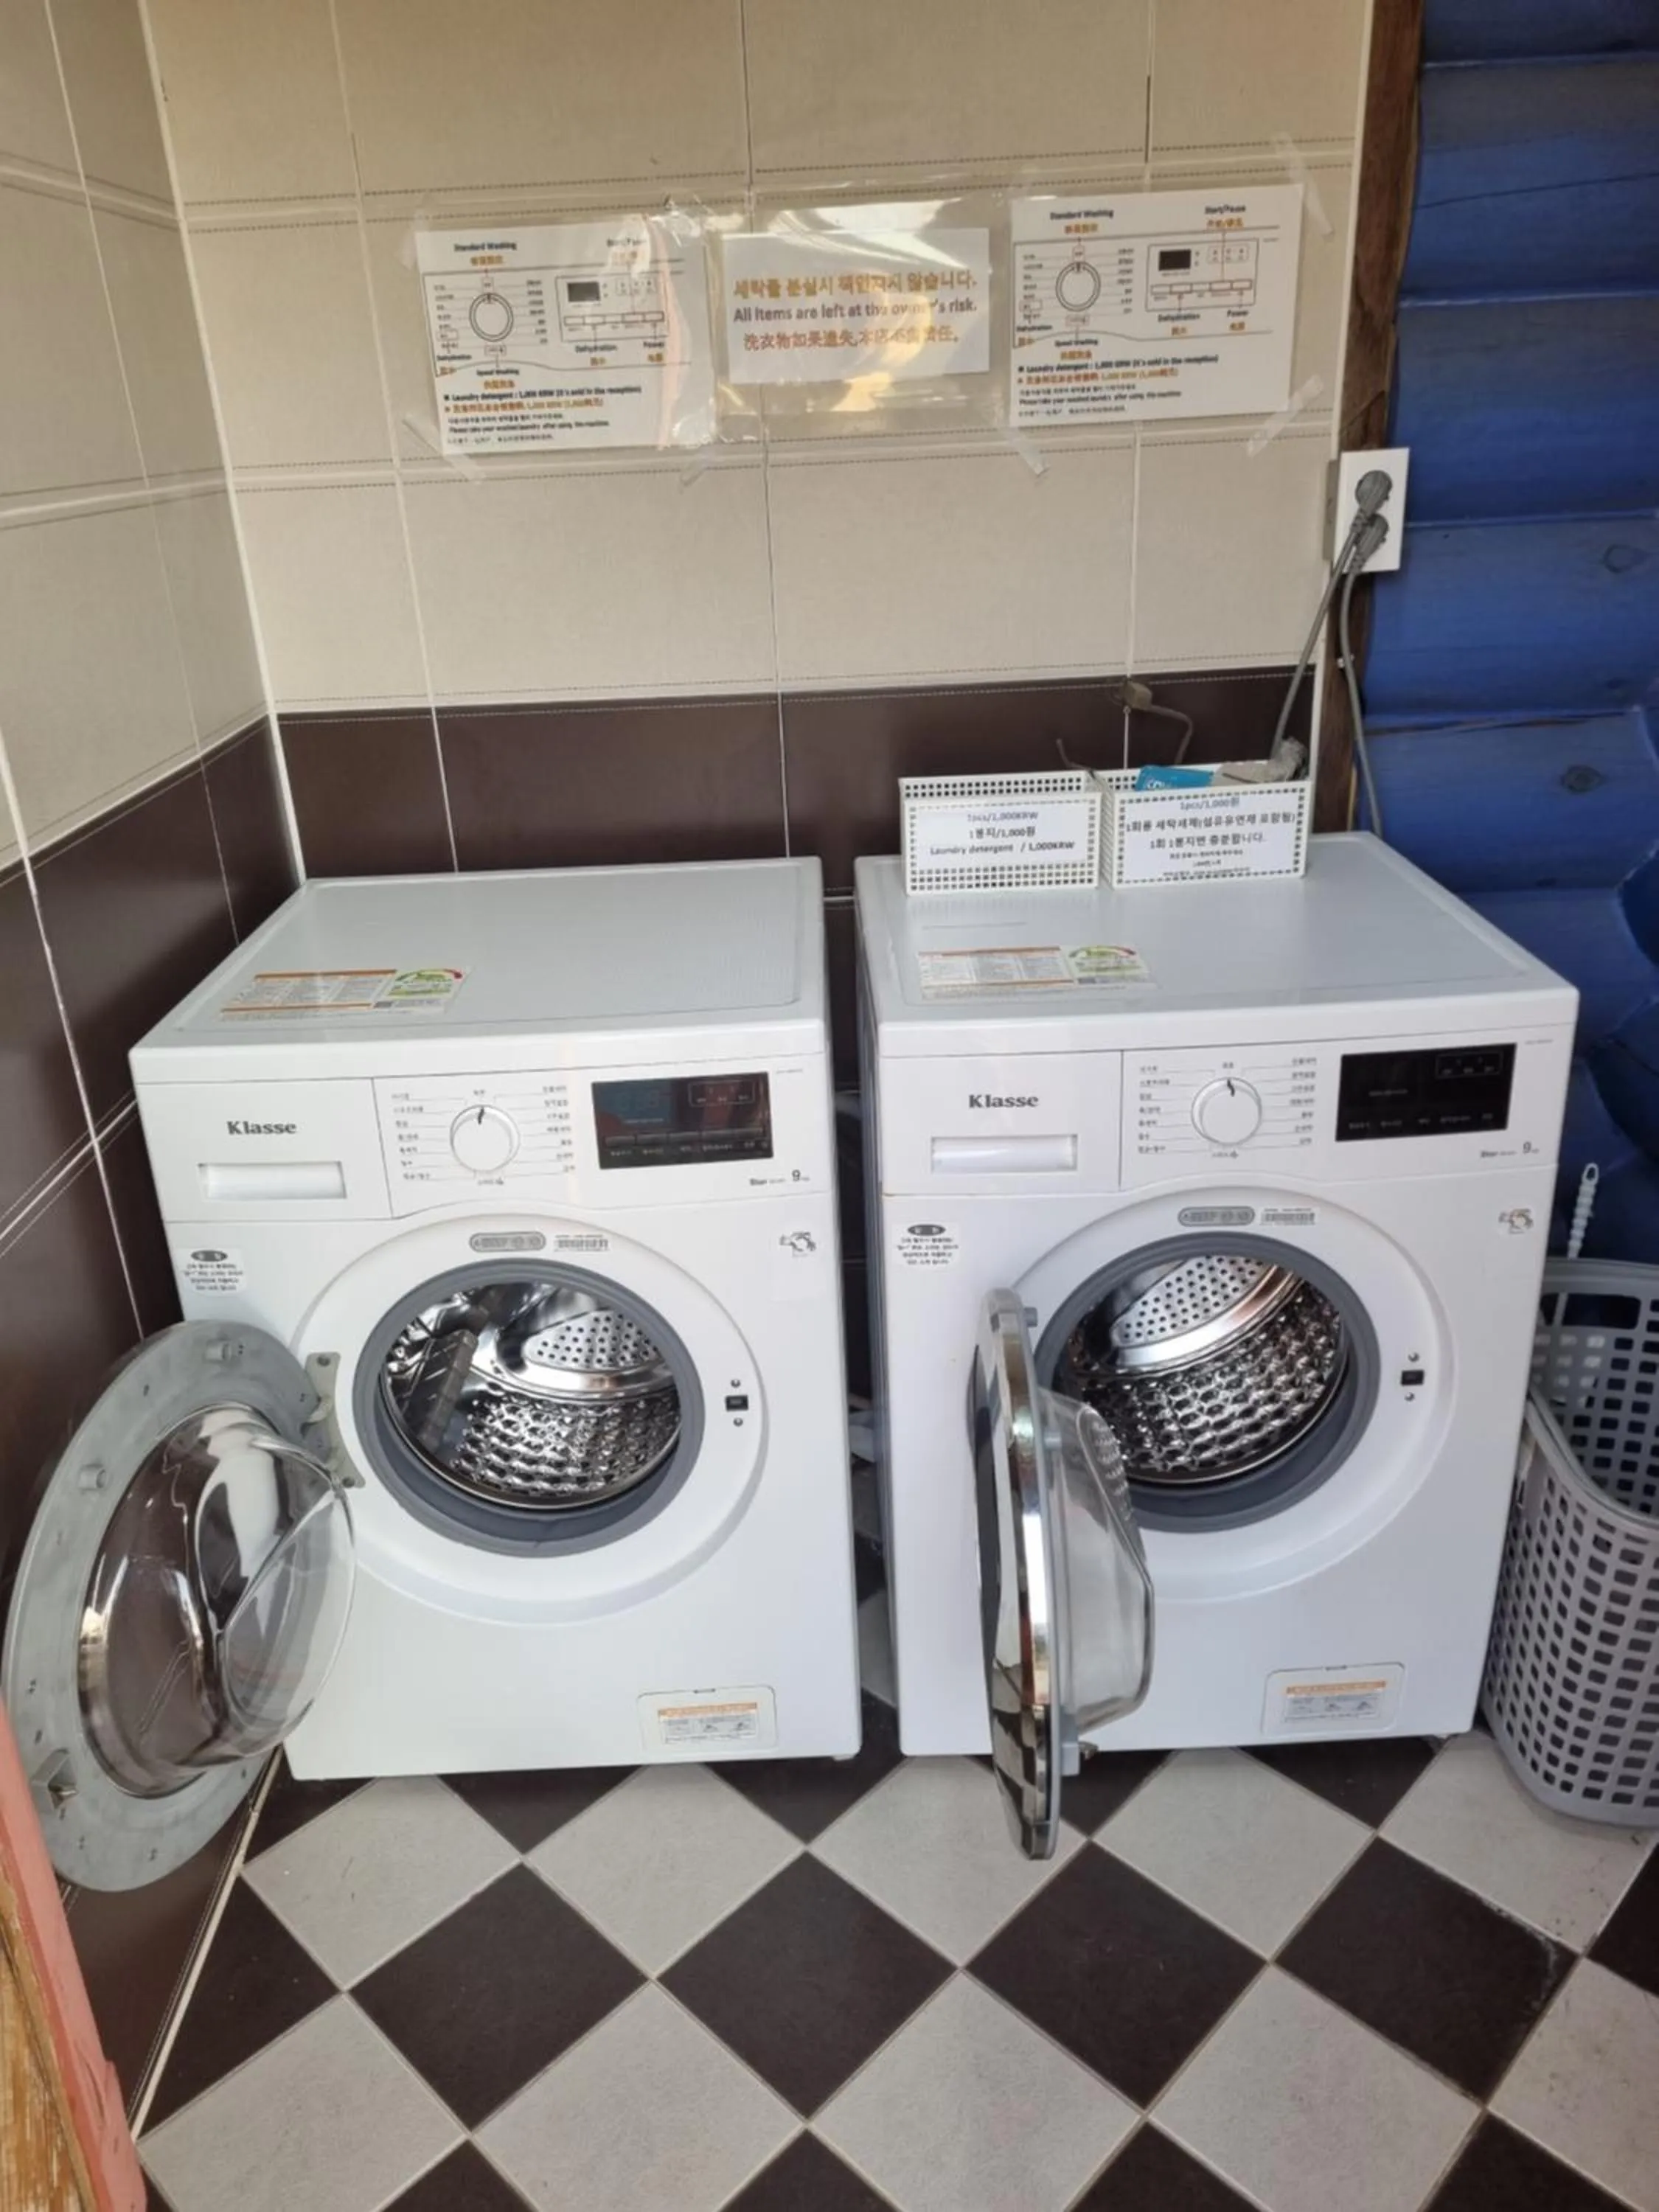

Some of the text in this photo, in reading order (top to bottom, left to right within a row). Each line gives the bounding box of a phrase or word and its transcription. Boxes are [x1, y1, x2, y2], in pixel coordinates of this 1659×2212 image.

[734, 306, 751, 321] All
[796, 308, 817, 319] are
[822, 302, 845, 319] left
[849, 304, 861, 317] at
[930, 846, 967, 855] Laundry
[969, 844, 1014, 854] detergent
[968, 1094, 1039, 1109] Klasse
[226, 1120, 297, 1135] Klasse
[792, 1169, 801, 1182] 9
